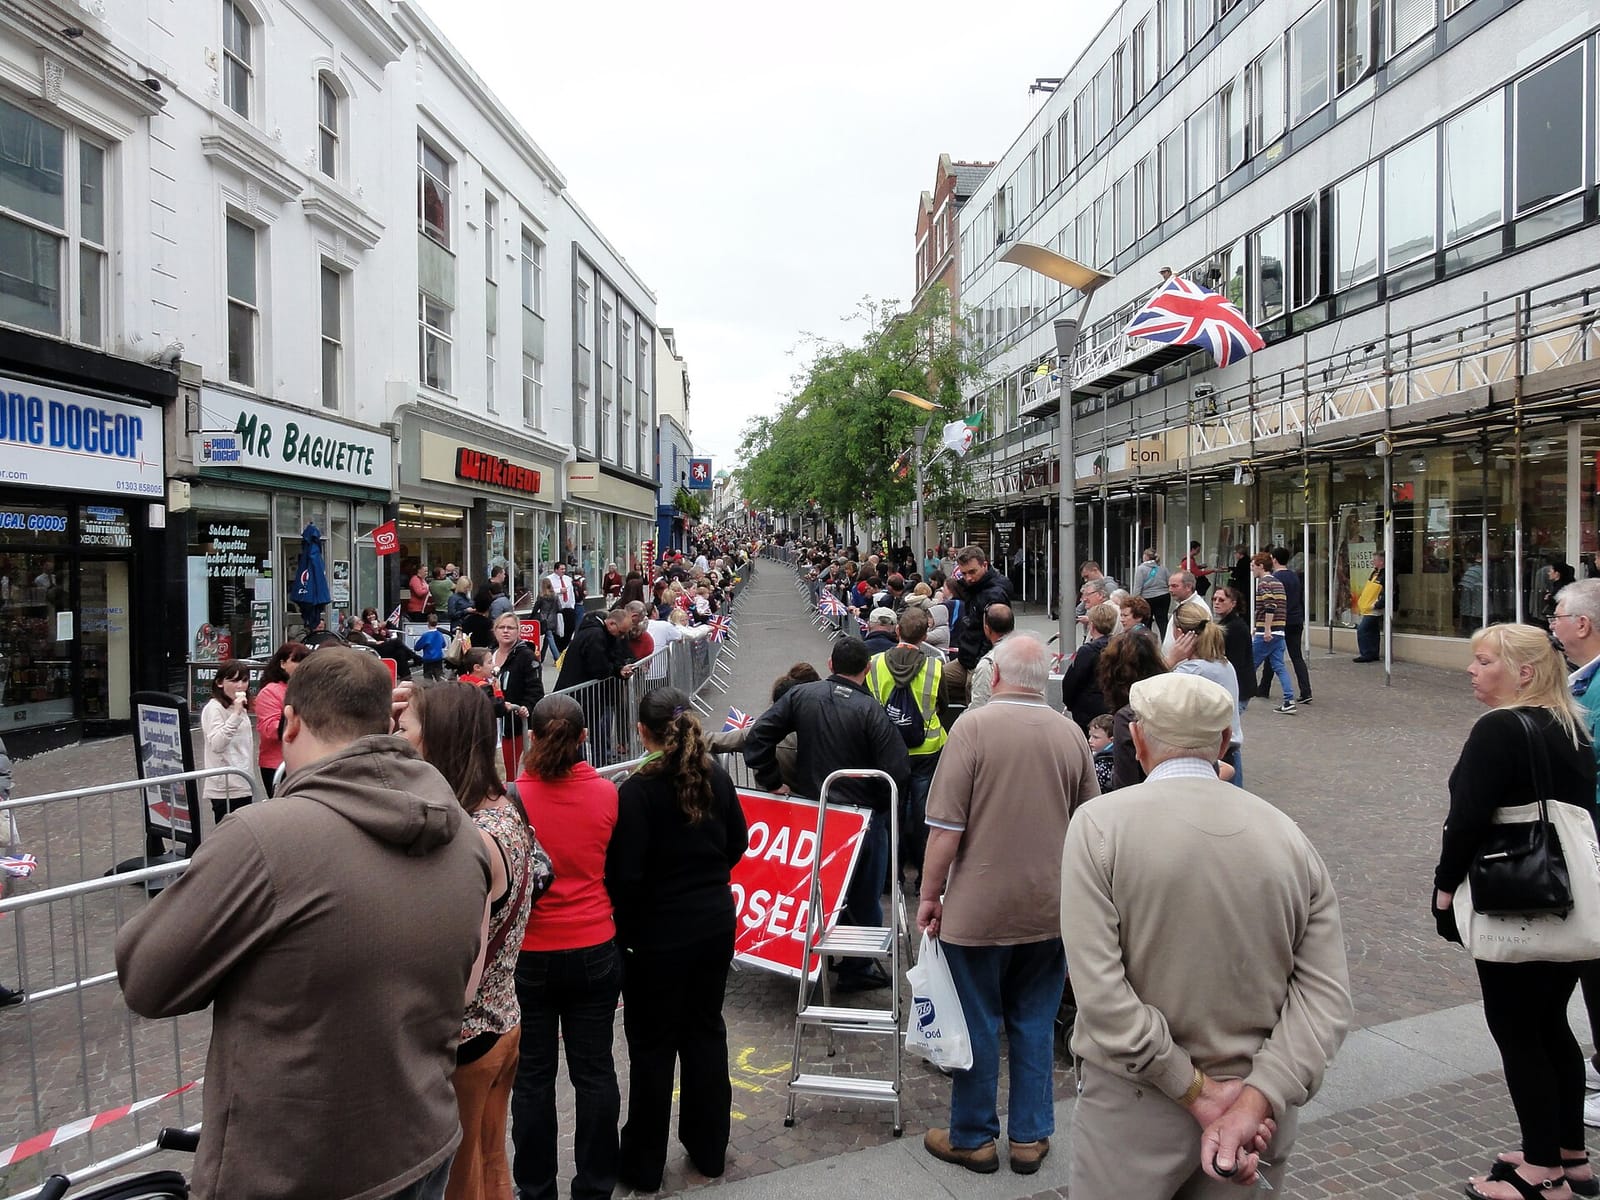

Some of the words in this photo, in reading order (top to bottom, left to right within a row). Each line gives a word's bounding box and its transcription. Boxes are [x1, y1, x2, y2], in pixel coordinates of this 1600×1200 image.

[237, 411, 272, 459] MR
[282, 422, 375, 476] BAGUETTE
[1131, 447, 1160, 462] bon
[0, 469, 28, 480] r.com
[116, 480, 138, 491] 01303
[0, 512, 25, 529] ICAL
[28, 515, 67, 531] GOODS
[208, 524, 231, 537] Salad
[114, 534, 132, 547] Wii
[213, 538, 247, 552] Baguettes
[228, 552, 256, 564] Potatoes
[221, 566, 236, 577] Cold
[744, 821, 817, 867] OAD
[731, 883, 819, 942] OSED
[1480, 934, 1526, 945] PRIMARK
